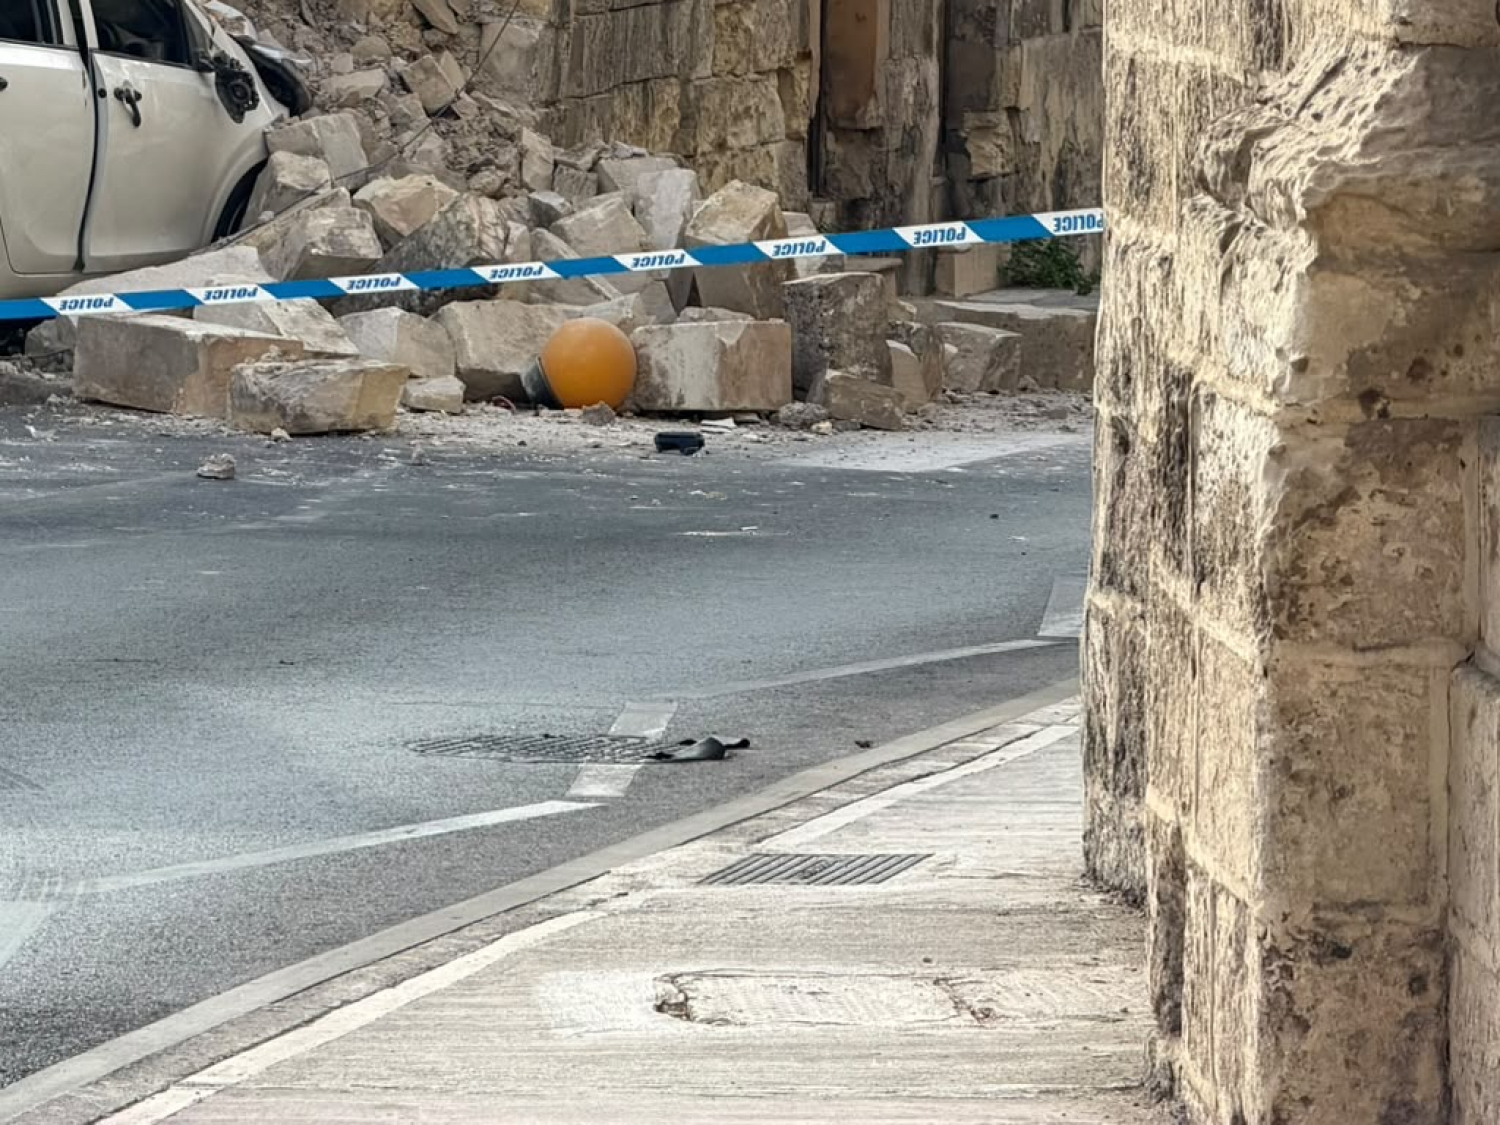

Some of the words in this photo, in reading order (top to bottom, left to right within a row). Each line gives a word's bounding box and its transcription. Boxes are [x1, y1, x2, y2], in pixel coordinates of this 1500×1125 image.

[913, 227, 967, 245] POLICE
[772, 240, 826, 256] POLICE
[632, 254, 685, 268] POLICE
[490, 265, 543, 279] POLICE
[347, 277, 401, 290] POLICE
[203, 287, 259, 301] POLICE
[59, 297, 114, 311] POLICE
